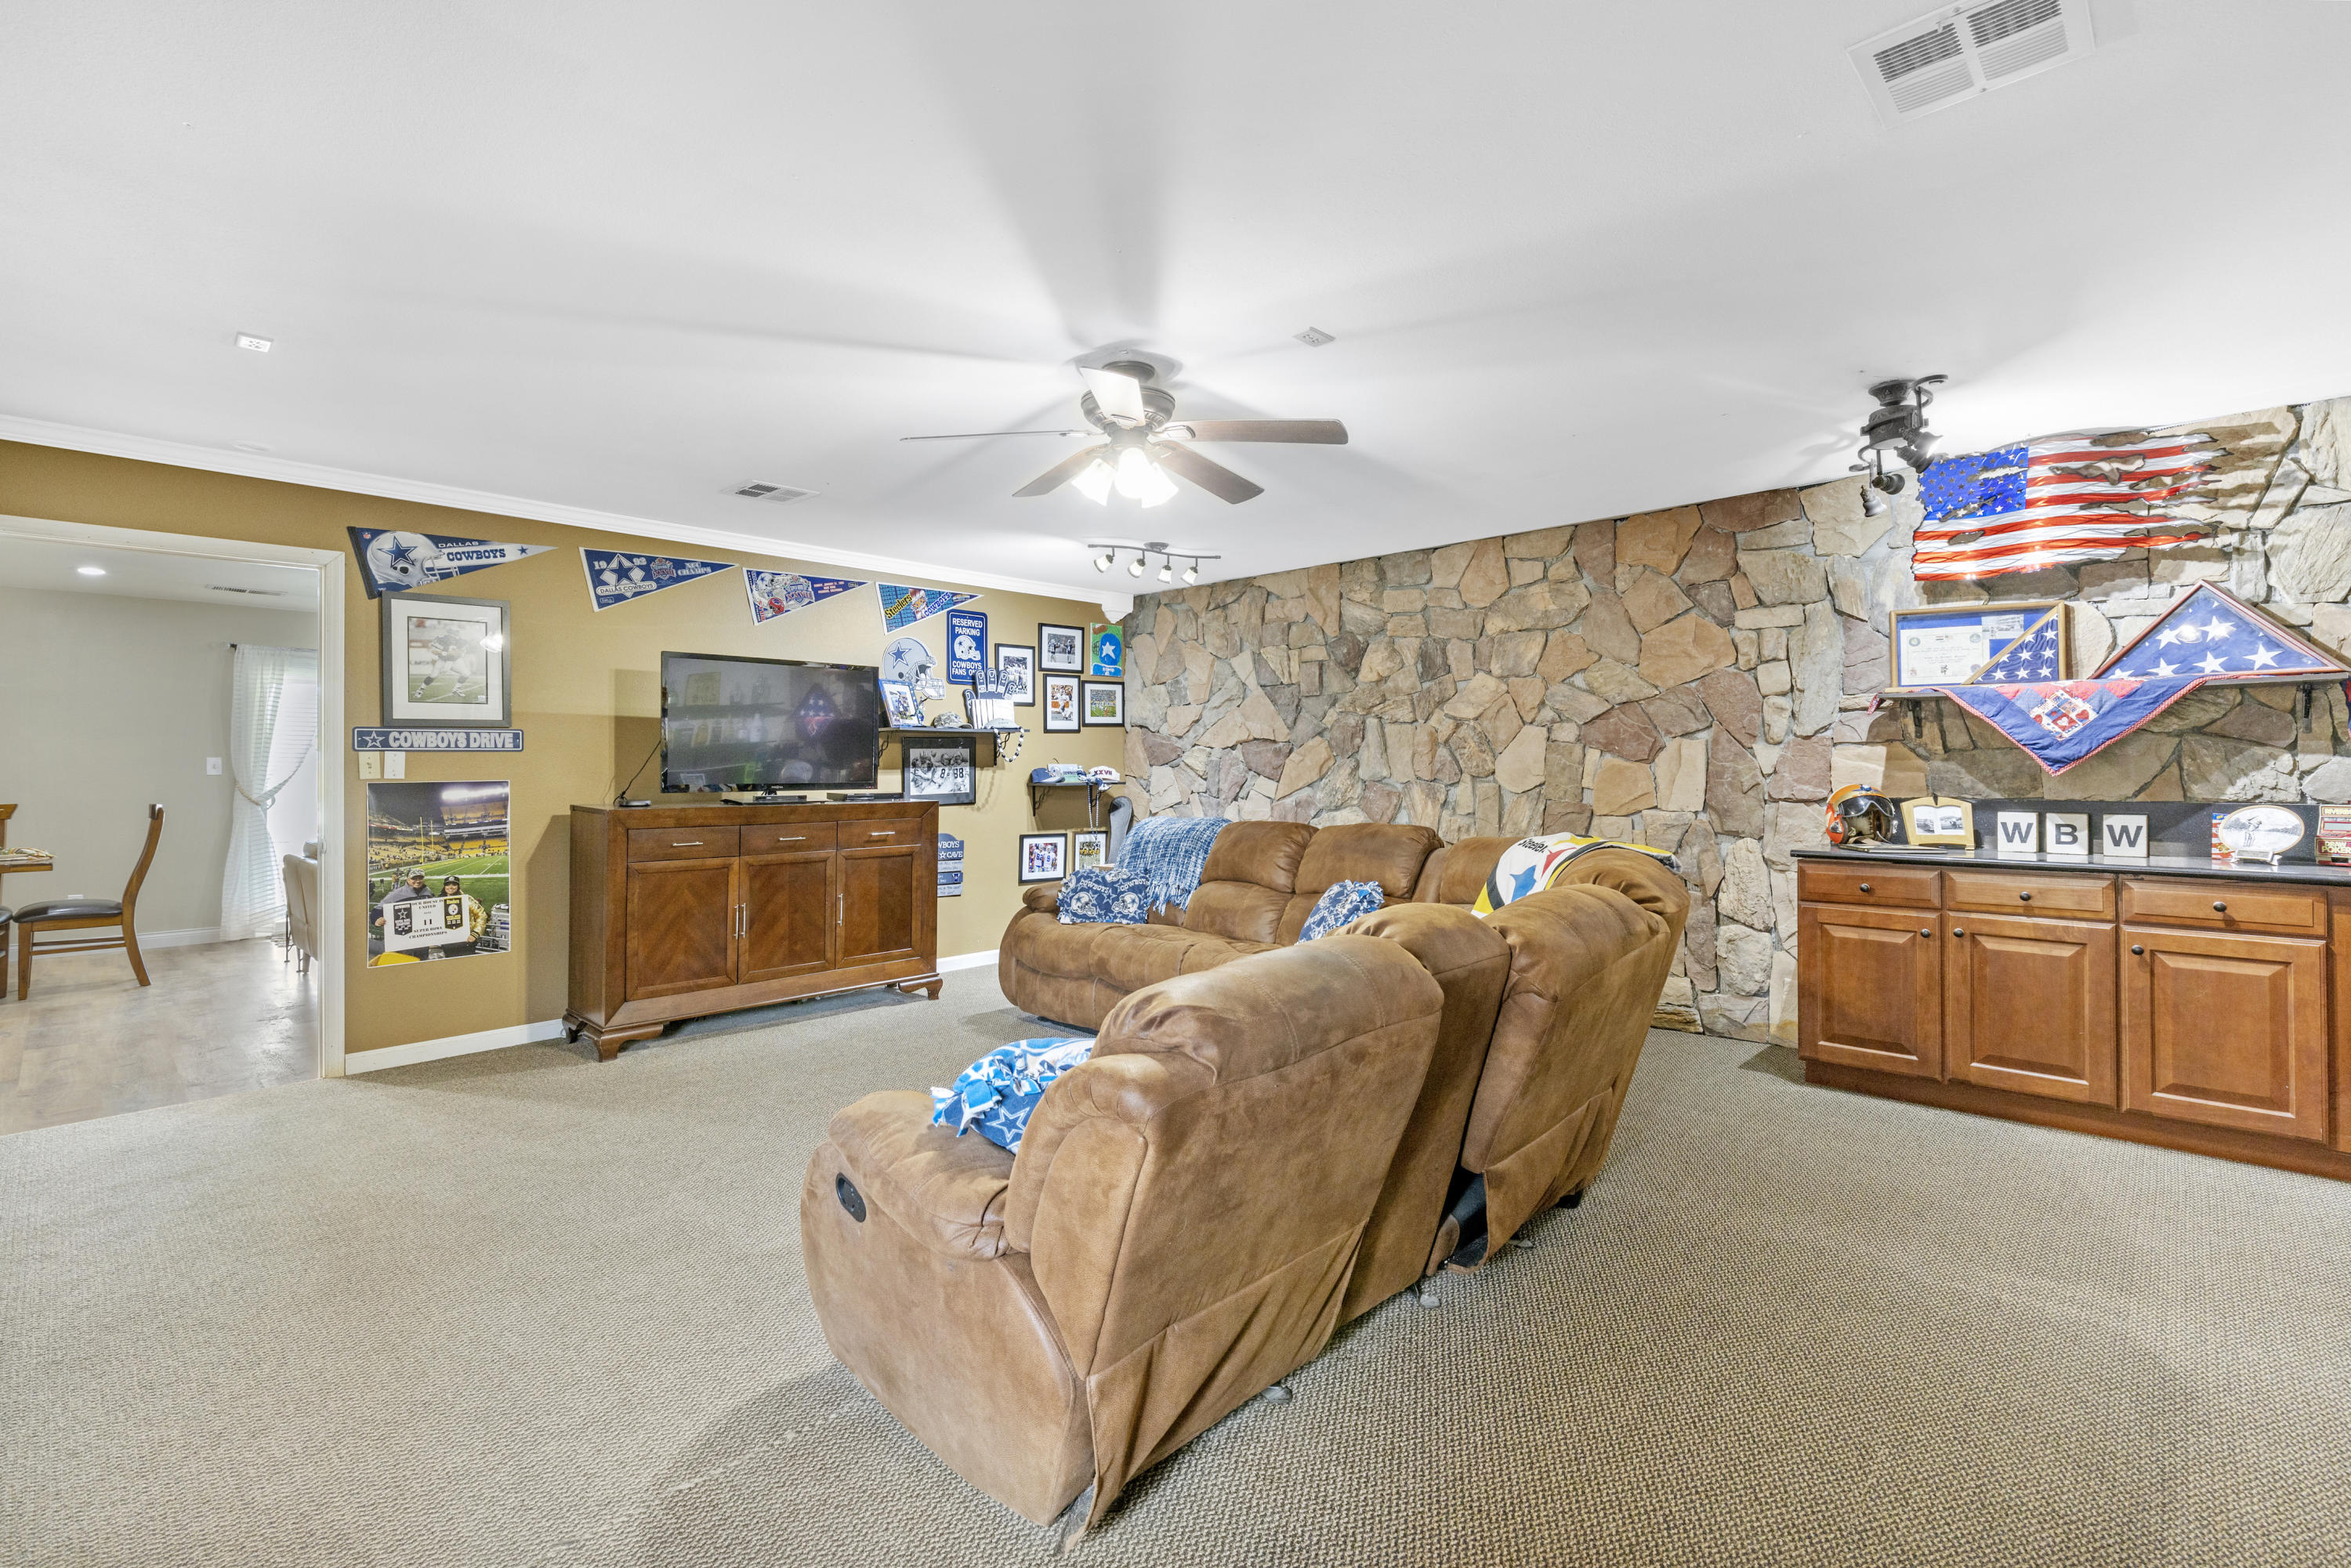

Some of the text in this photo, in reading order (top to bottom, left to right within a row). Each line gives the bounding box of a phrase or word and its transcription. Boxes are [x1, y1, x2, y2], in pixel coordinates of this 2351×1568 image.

[447, 548, 506, 562] COWBOYS
[593, 560, 607, 570] 19
[677, 567, 712, 576] CHAMPS
[884, 594, 912, 619] Steelers
[925, 592, 951, 617] COWBOYS
[952, 617, 983, 628] RESERVED
[955, 627, 980, 636] PARKING
[952, 661, 982, 669] COWBOYS
[389, 732, 513, 748] COWBOYS DRIVE
[2000, 822, 2143, 848] W B W
[2321, 846, 2351, 854] POKER
[1079, 879, 1110, 893] COWBOYS
